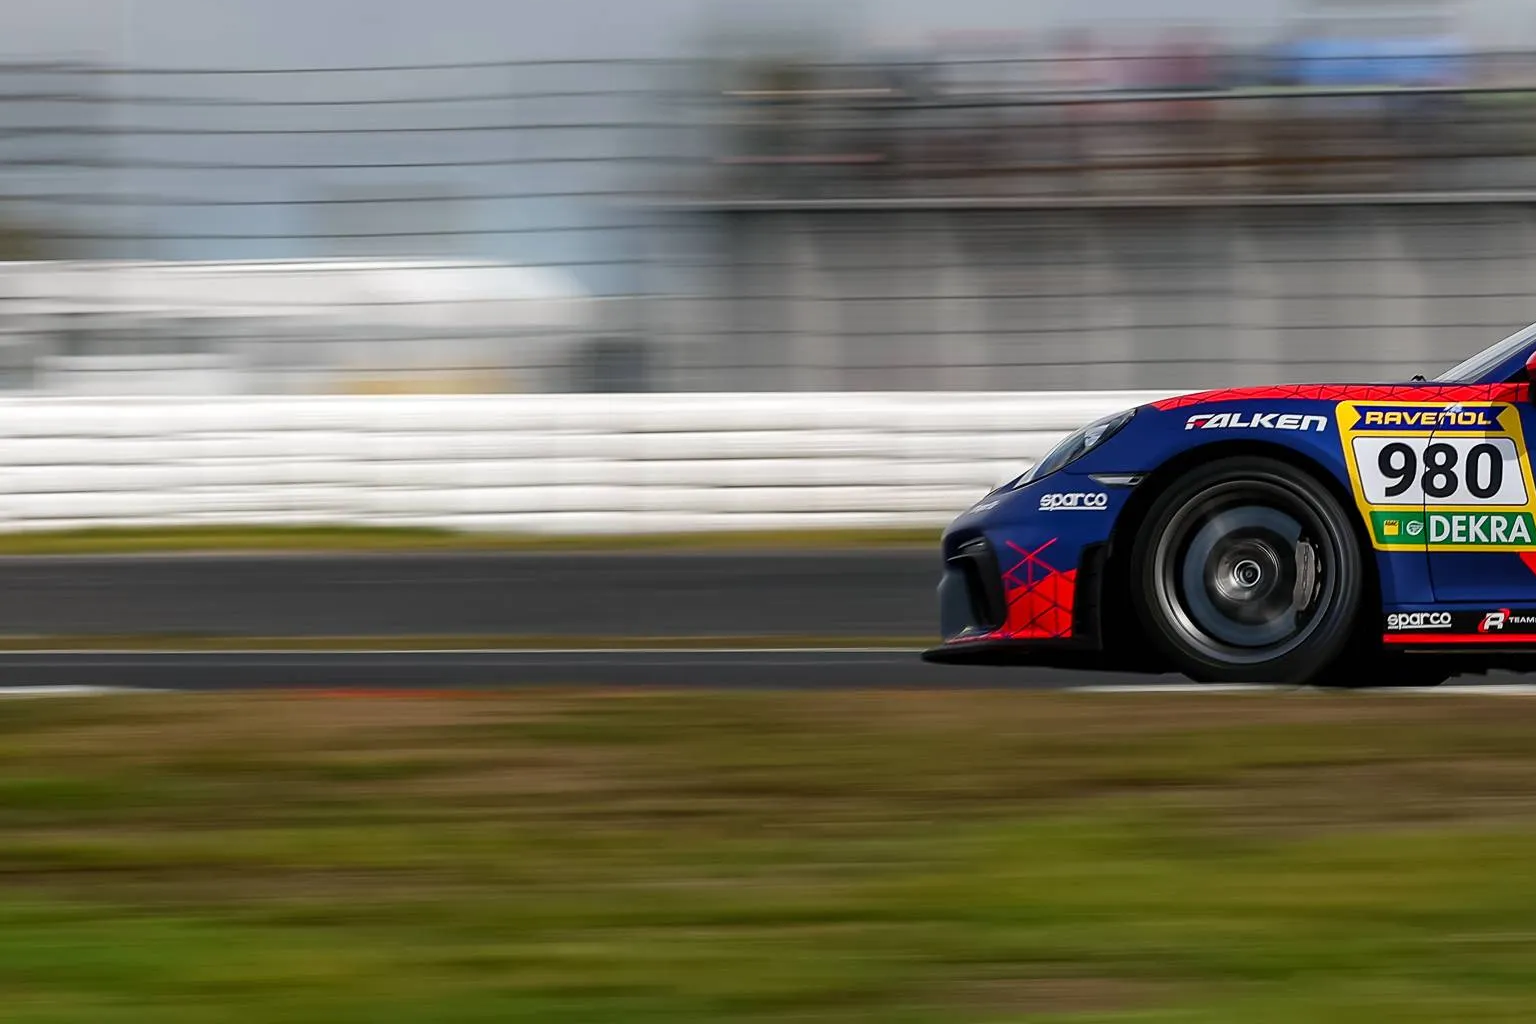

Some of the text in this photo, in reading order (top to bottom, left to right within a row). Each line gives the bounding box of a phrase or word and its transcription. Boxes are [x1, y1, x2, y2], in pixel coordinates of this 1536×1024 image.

[1184, 413, 1328, 432] FALKEN
[1377, 442, 1504, 498] 980
[1039, 492, 1108, 511] sparco
[1429, 515, 1532, 543] DEKRA
[1387, 611, 1452, 629] sparco
